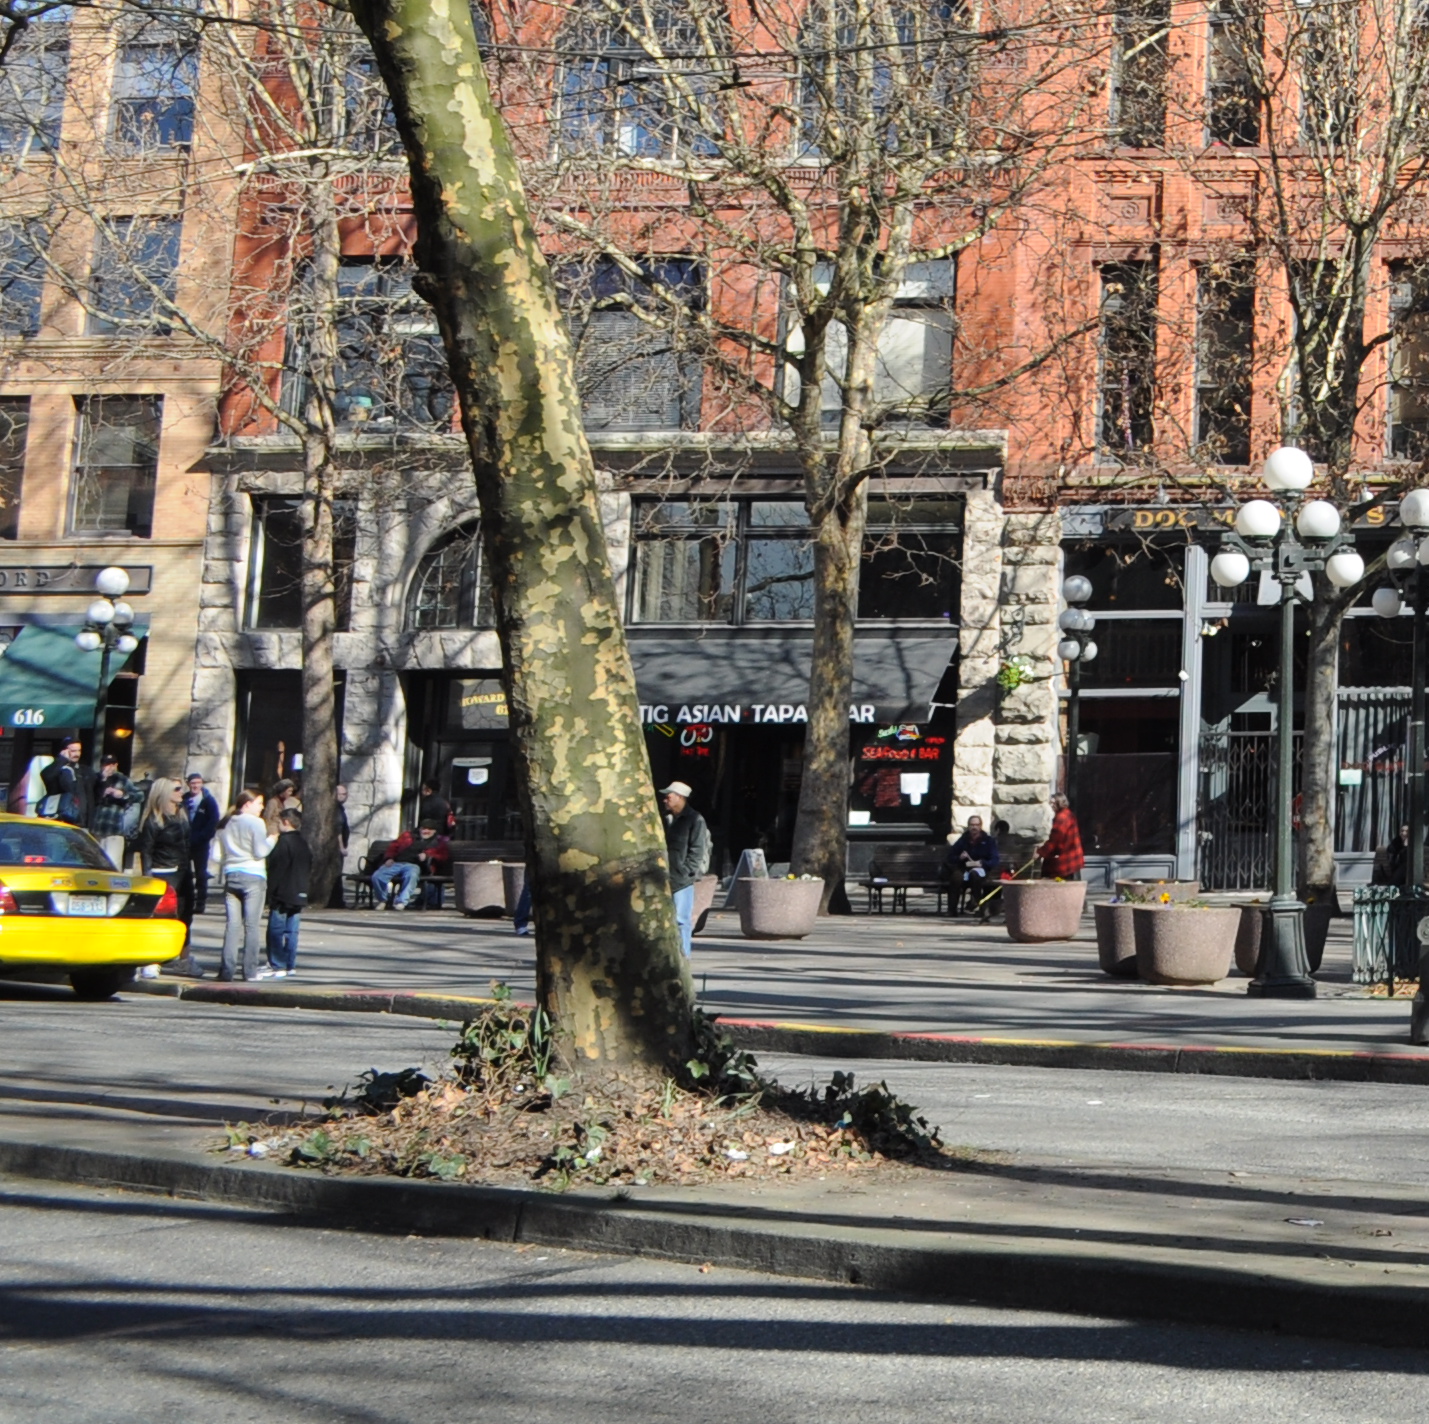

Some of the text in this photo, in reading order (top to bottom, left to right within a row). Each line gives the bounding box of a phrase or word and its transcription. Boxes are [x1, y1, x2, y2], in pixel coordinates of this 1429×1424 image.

[1134, 509, 1197, 528] DOC
[13, 708, 45, 725] 616
[676, 704, 741, 723] ASIAN
[751, 704, 809, 723] TAPA
[848, 704, 876, 723] AR
[919, 747, 940, 759] BAR
